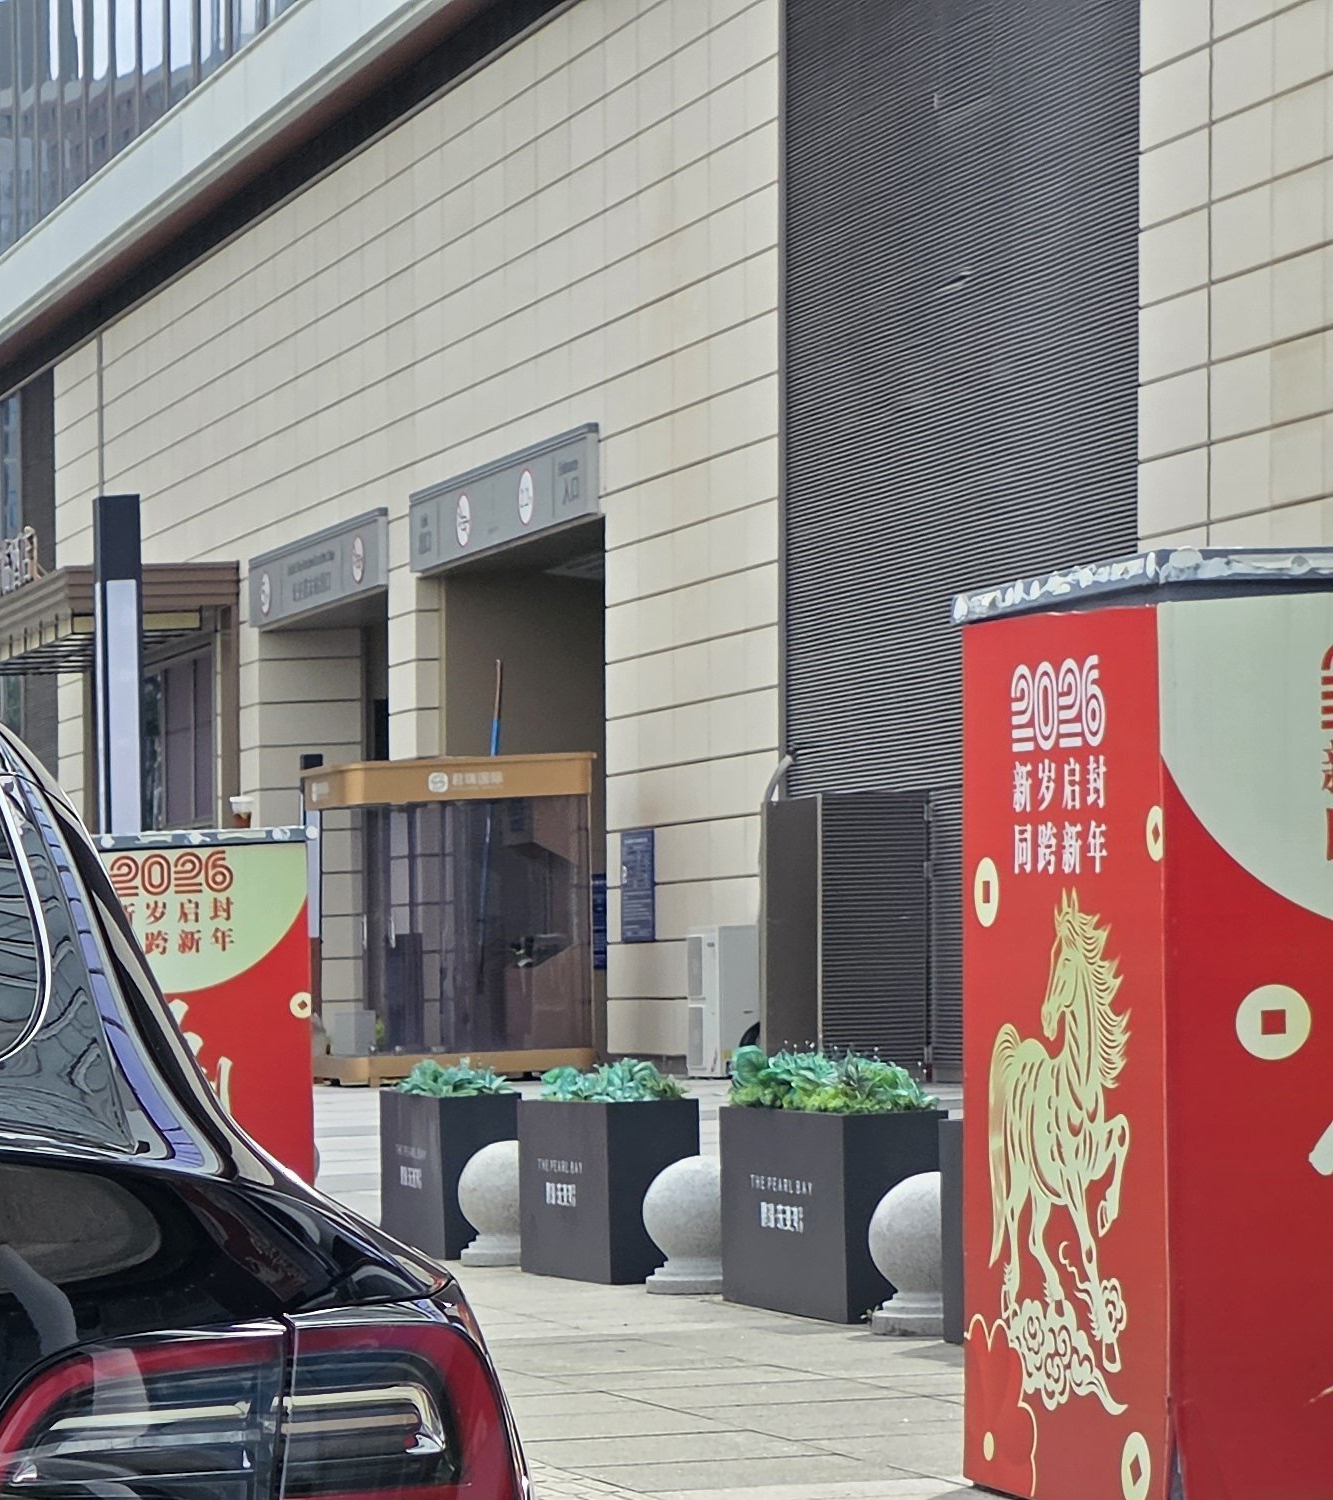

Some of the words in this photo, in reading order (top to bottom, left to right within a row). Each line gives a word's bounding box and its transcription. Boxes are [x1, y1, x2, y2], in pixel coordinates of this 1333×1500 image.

[1010, 654, 1105, 752] 2026
[1012, 755, 1107, 813] 新岁启封
[110, 849, 233, 897] 2026
[1013, 819, 1108, 875] 同跨新年
[144, 927, 235, 956] 跨新年
[750, 1173, 765, 1190] THE
[767, 1176, 794, 1194] PEARL
[795, 1179, 813, 1195] BAY
